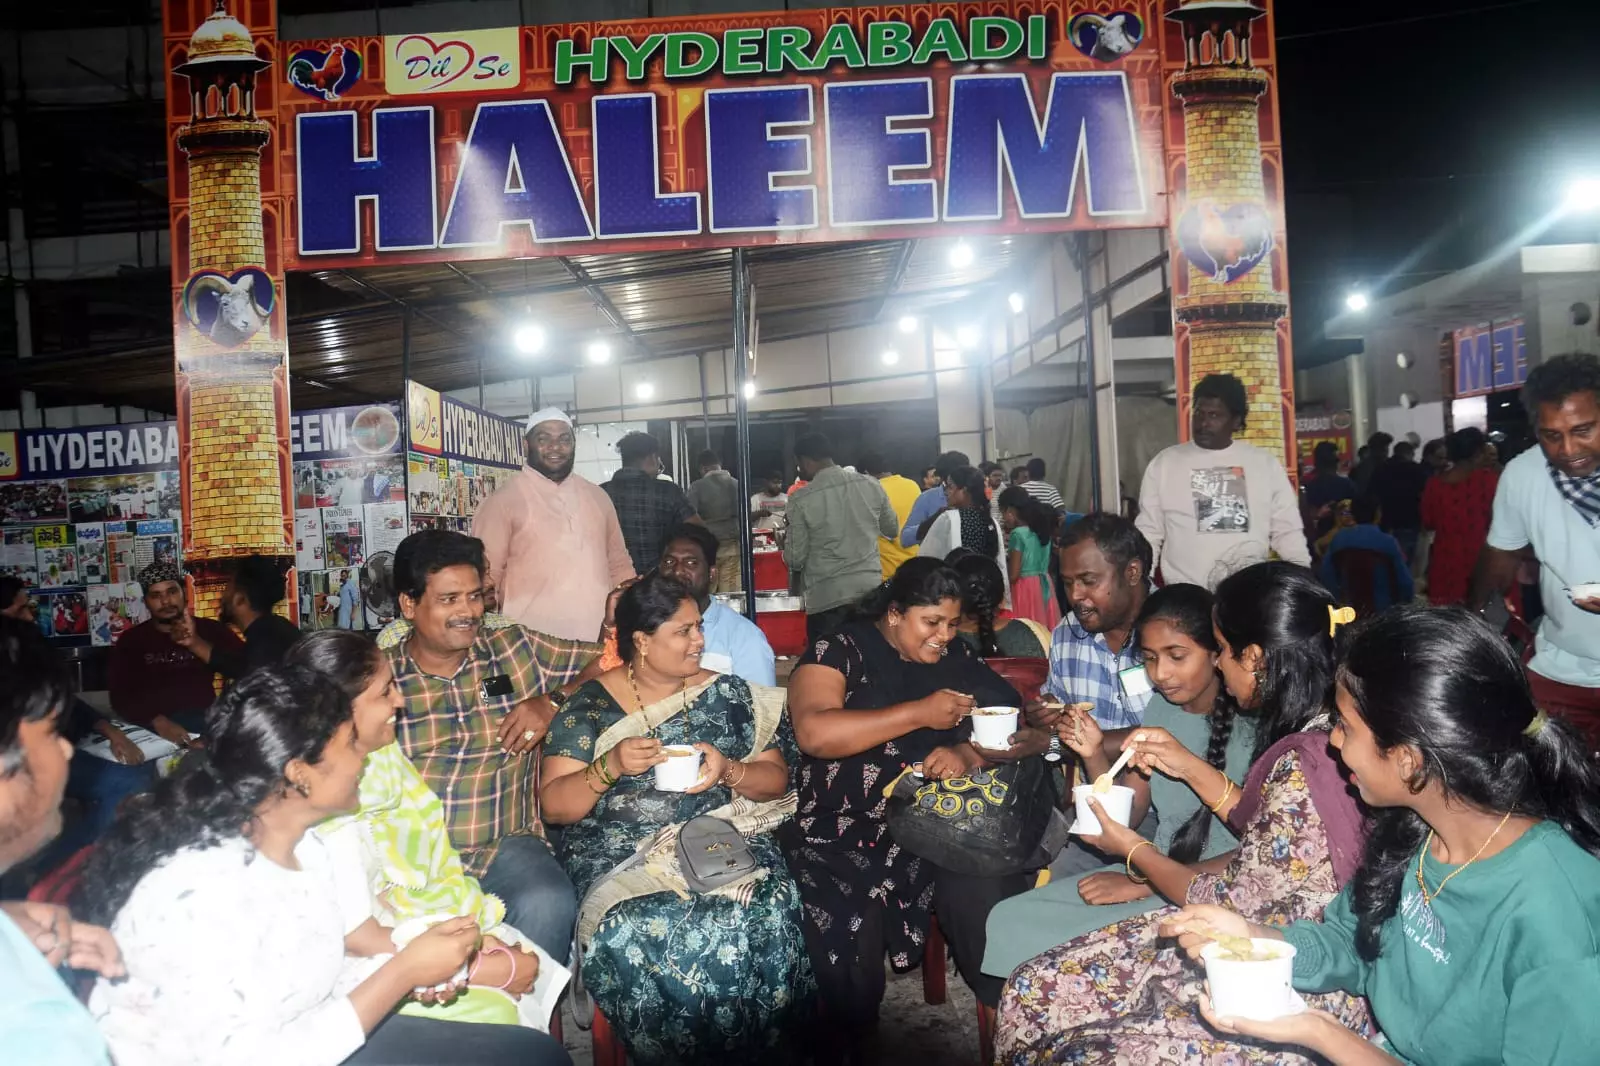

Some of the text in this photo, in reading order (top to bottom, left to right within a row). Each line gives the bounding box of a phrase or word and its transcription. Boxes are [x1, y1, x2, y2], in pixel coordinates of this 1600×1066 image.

[405, 55, 510, 80] Dil Se
[554, 14, 1047, 85] HYDERABADI
[295, 71, 1148, 257] HALEEM
[26, 425, 179, 472] HYDERABA
[443, 400, 504, 463] HYDERABADI
